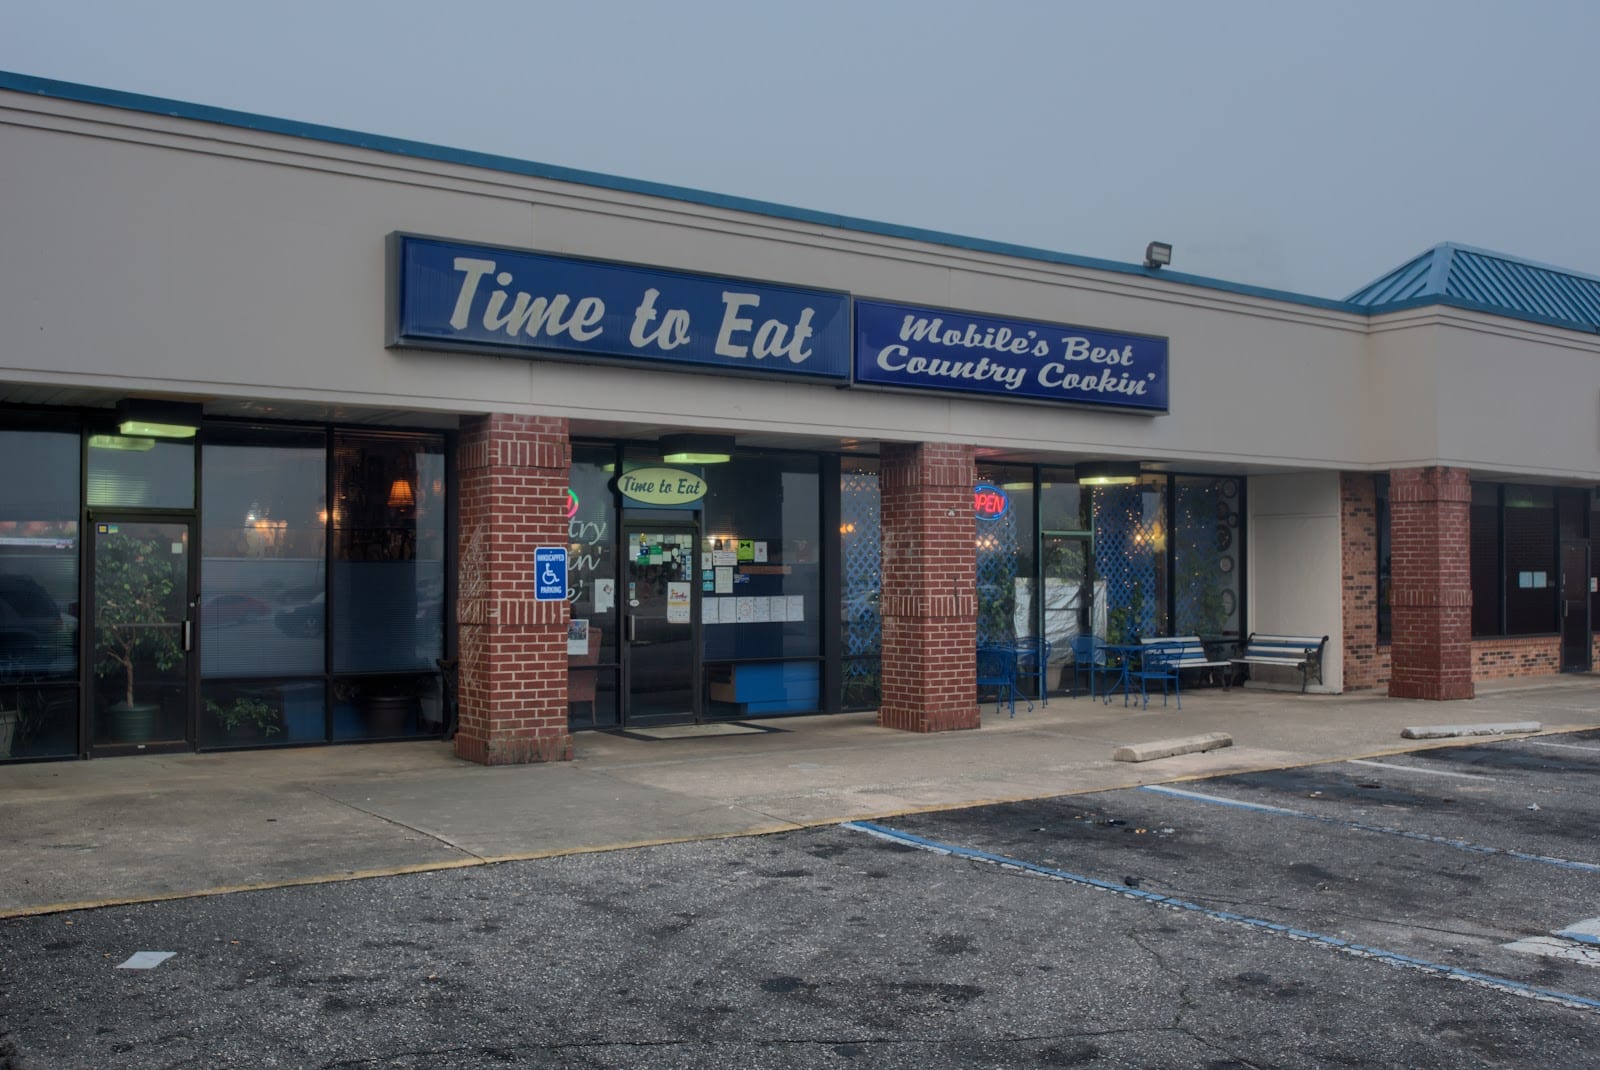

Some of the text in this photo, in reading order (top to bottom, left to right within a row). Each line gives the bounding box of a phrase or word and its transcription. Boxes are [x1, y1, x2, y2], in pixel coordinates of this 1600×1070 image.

[449, 257, 815, 364] Time to Eat
[899, 314, 1133, 366] Mobile's Best
[877, 344, 1156, 395] Country Cookin'
[623, 475, 701, 495] Time to Eat
[540, 585, 562, 593] PARKING
